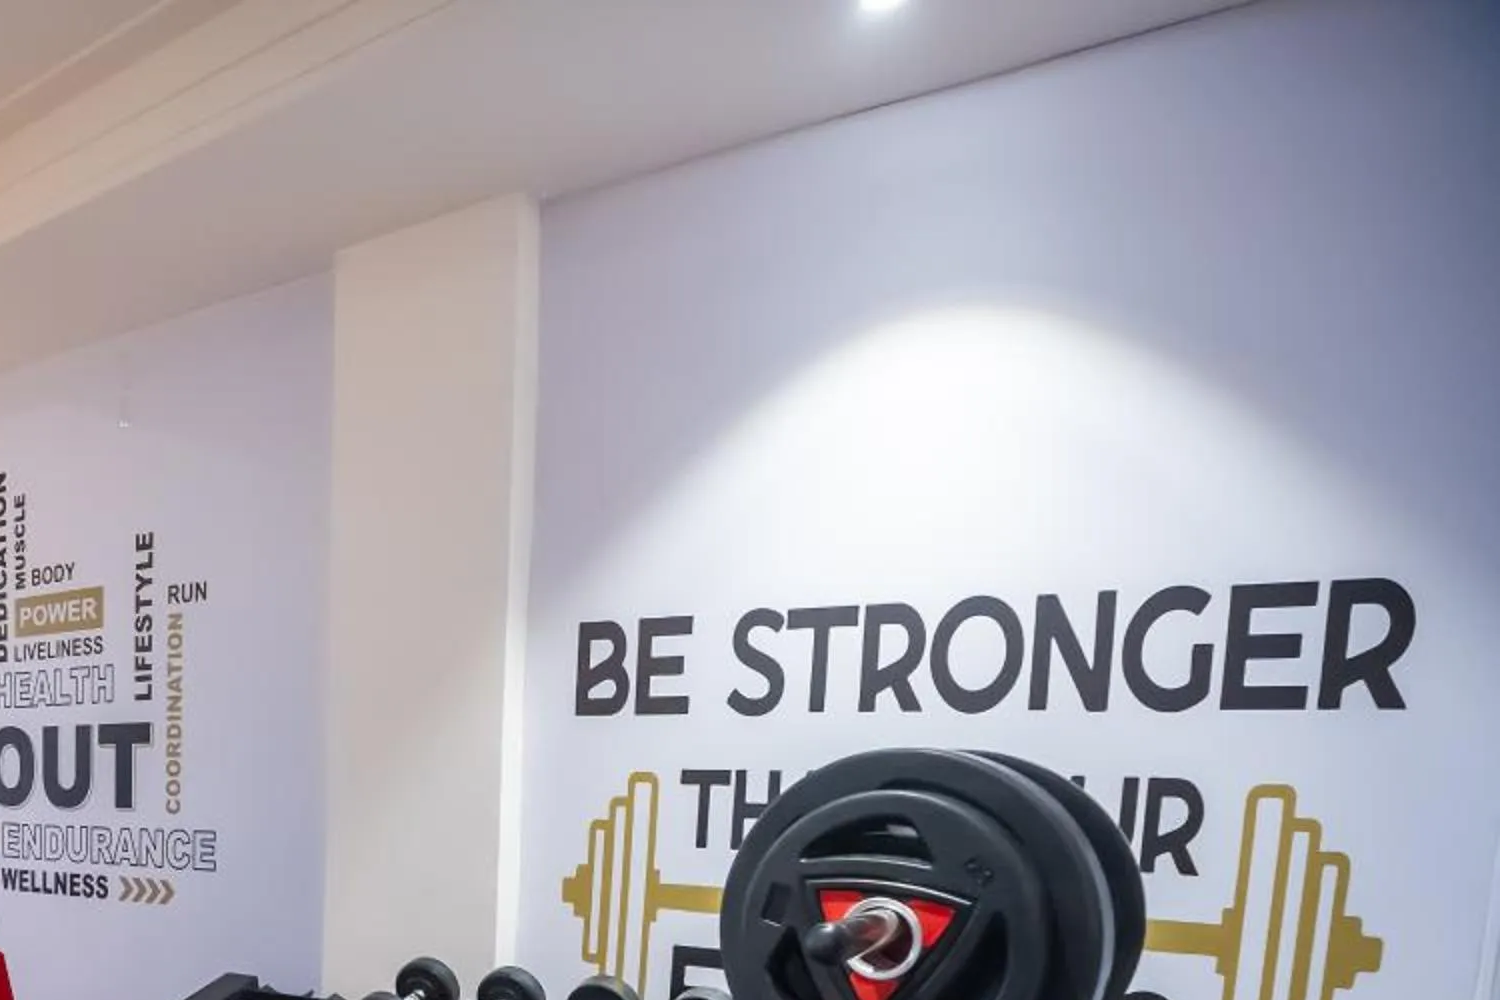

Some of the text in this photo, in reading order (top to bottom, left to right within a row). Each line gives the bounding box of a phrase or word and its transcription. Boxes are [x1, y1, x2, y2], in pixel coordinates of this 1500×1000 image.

[14, 493, 26, 590] MUSCLE
[31, 562, 75, 586] BODY
[167, 581, 207, 604] RUN
[19, 597, 97, 628] POWER
[134, 531, 154, 701] LIFESTYLE
[14, 635, 104, 663] LIVELINESS
[574, 577, 1416, 717] BE STRONGER
[166, 613, 183, 814] COORDINATION
[680, 769, 782, 850] TH
[2, 822, 217, 872] ENDURANCE
[1, 868, 109, 899] WELLNESS
